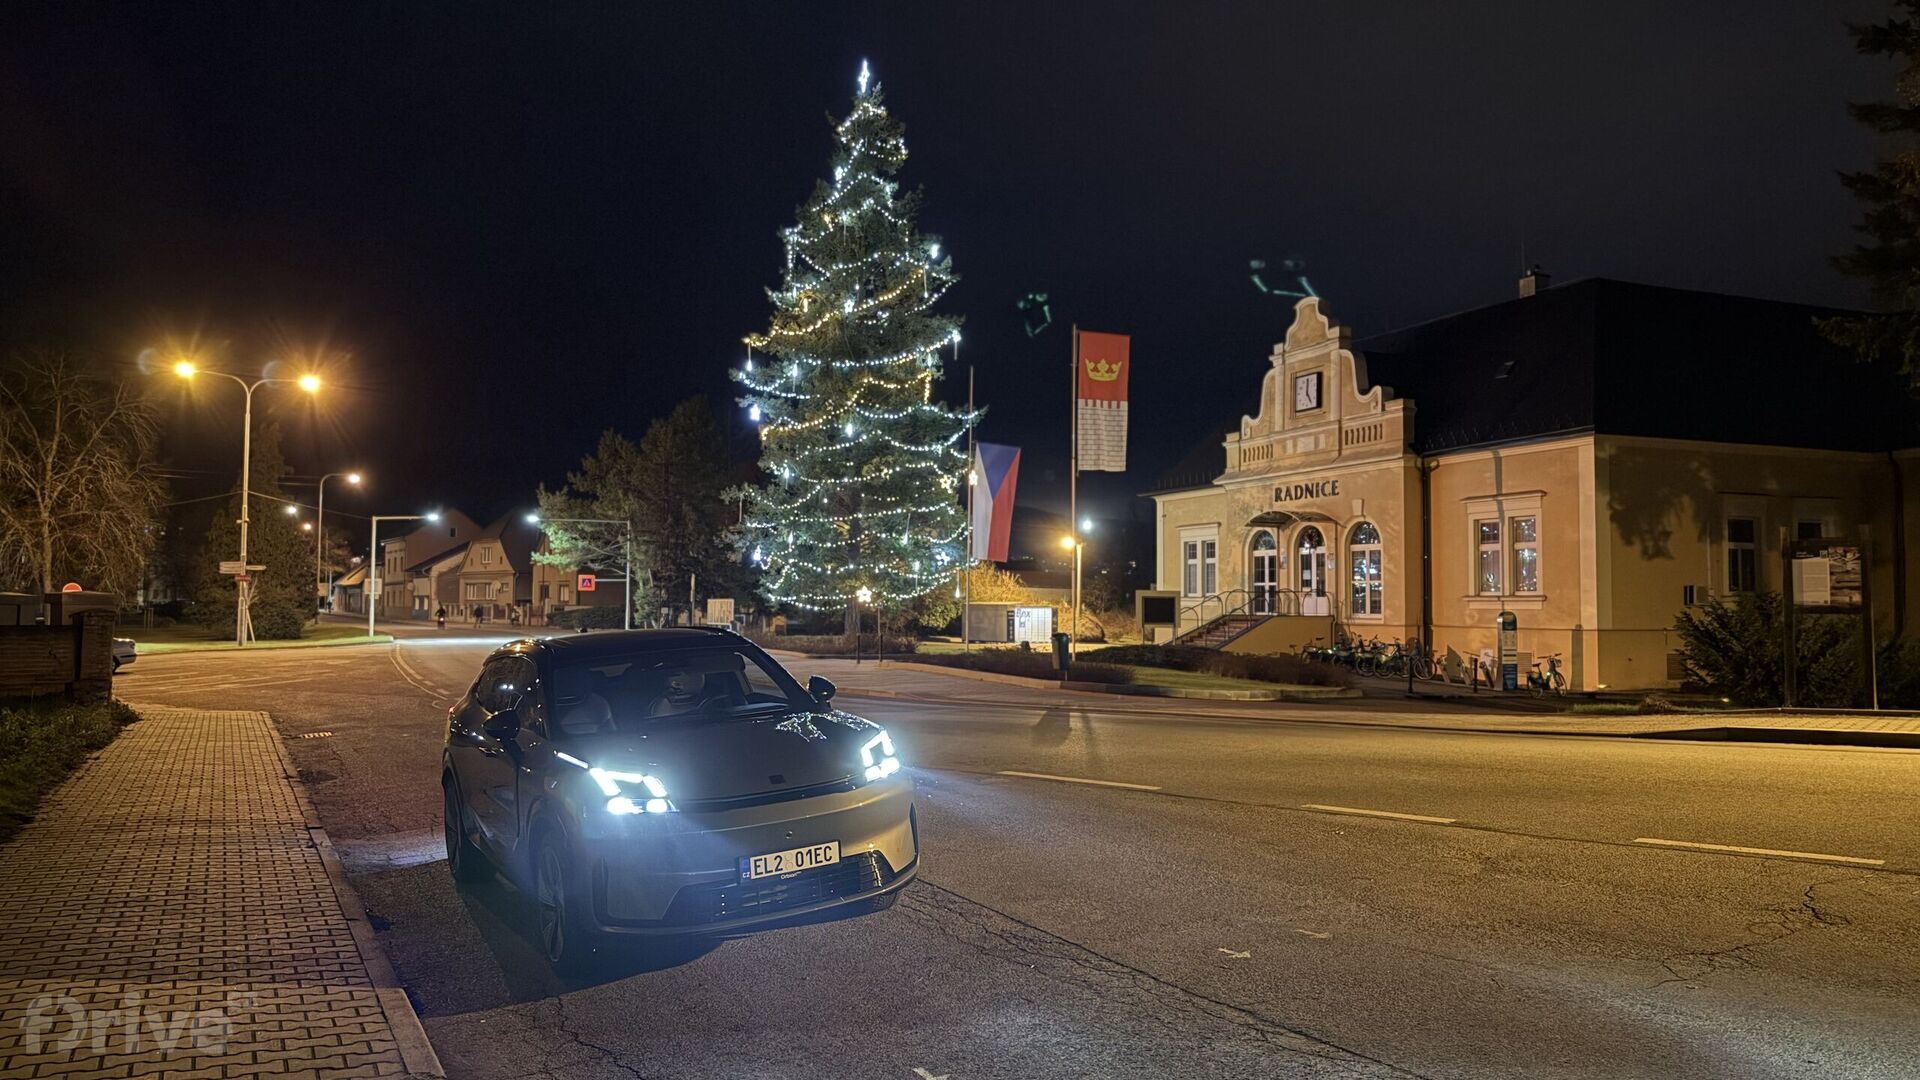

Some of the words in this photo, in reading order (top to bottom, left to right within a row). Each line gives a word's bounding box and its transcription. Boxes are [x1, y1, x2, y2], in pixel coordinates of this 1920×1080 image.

[1274, 480, 1340, 502] RADNICE
[754, 855, 783, 876] EL2
[795, 846, 832, 867] 01EC
